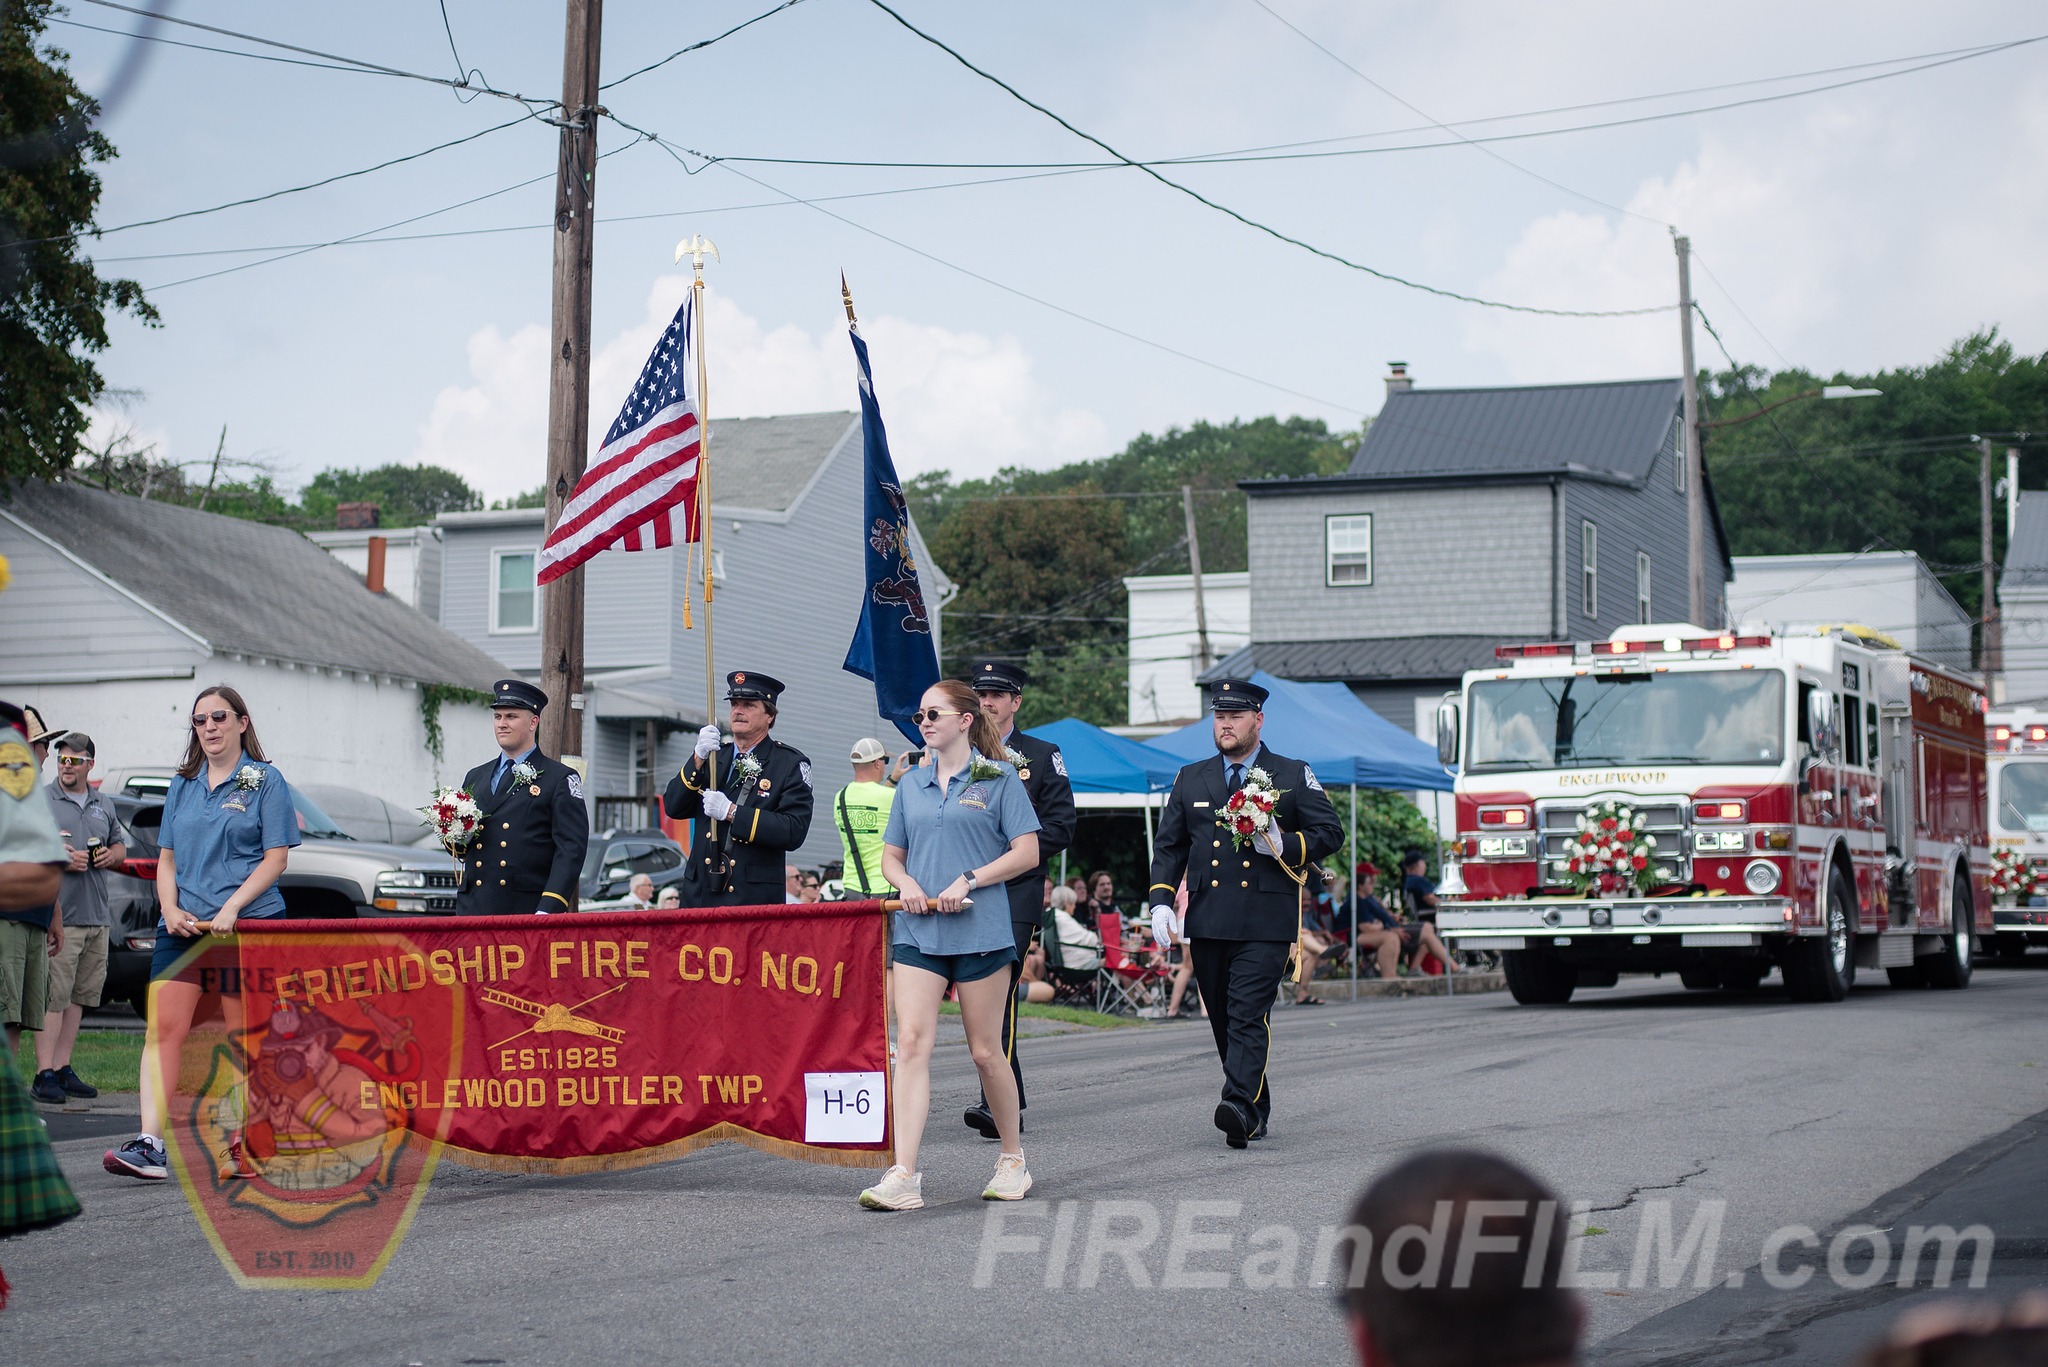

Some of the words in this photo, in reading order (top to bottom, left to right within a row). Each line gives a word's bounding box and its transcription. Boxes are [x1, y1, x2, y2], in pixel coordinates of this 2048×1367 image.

[1559, 772, 1668, 787] ENGLEWOOD
[275, 944, 526, 1013] FRIENDSHIP
[550, 940, 650, 979] FIRE
[678, 944, 742, 986] CO.
[360, 1077, 546, 1109] ENGLEWOOD
[557, 1075, 684, 1108] BUTLER
[698, 1074, 768, 1104] TWP.
[823, 1089, 870, 1114] H-6
